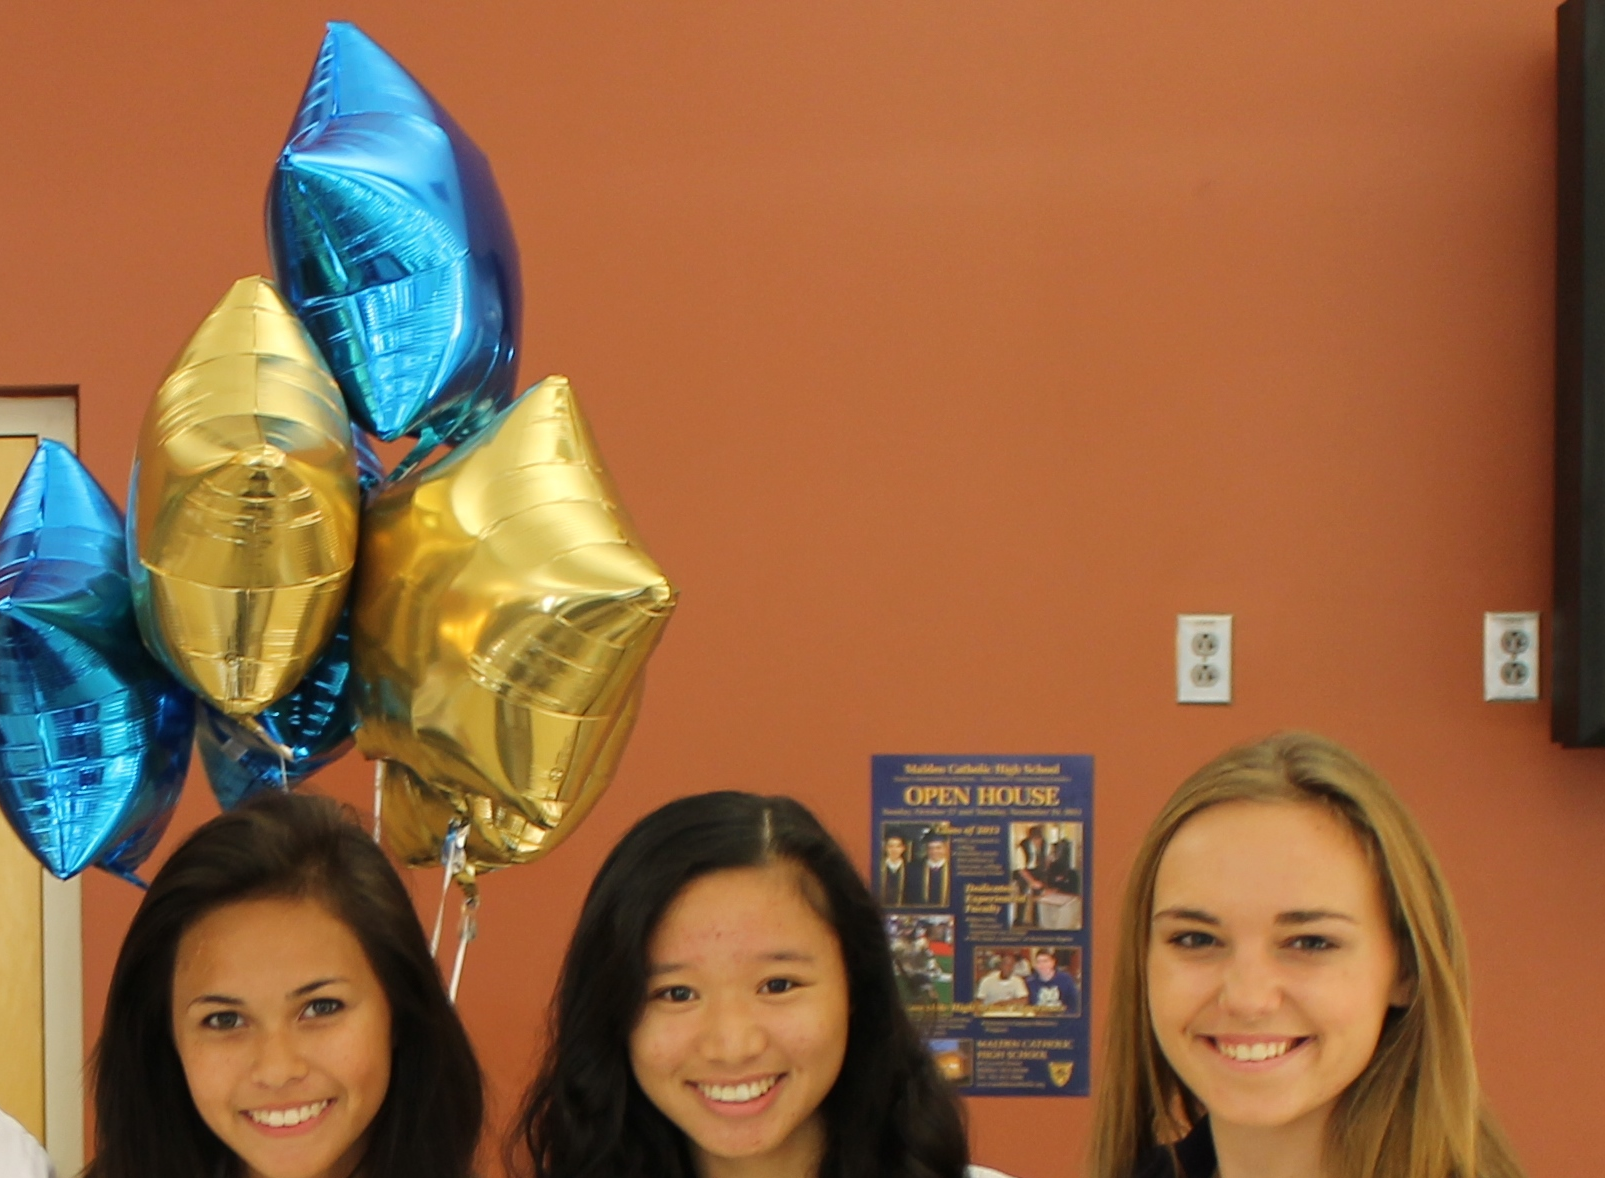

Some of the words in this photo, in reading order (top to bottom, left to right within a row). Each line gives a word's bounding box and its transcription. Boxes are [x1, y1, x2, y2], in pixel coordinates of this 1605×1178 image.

[948, 763, 990, 775] Catholic
[996, 764, 1021, 776] High
[1023, 763, 1060, 775] School
[904, 786, 971, 806] OPEN
[977, 786, 1060, 806] HOUSE
